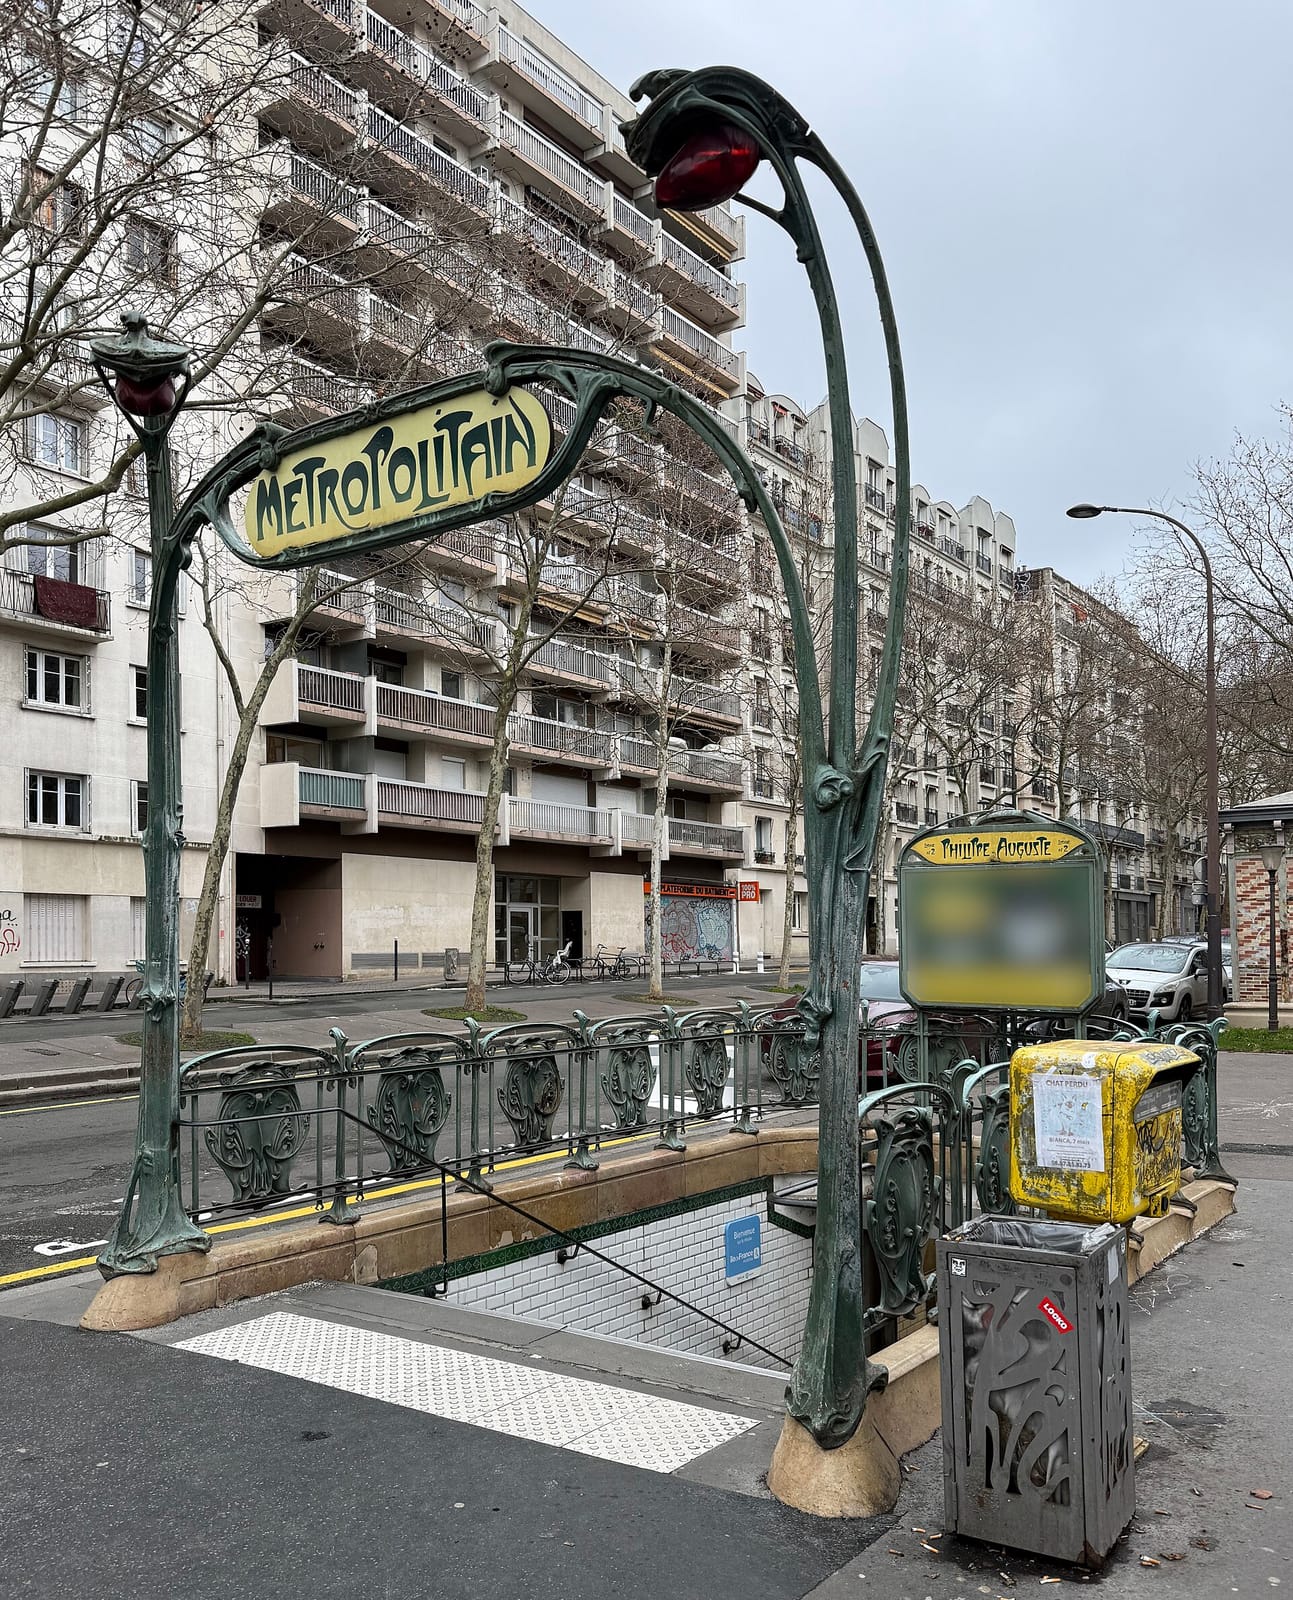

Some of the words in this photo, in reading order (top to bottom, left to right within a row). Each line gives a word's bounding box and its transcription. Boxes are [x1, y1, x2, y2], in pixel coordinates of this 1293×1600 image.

[256, 395, 537, 541] METROPOLITAIN
[940, 838, 989, 860] PHILIPPE
[998, 837, 1051, 859] AUGUSTE
[696, 885, 704, 894] DU
[741, 891, 756, 899] PRO
[1045, 1079, 1064, 1087] CHAT
[1065, 1080, 1088, 1088] PERDU
